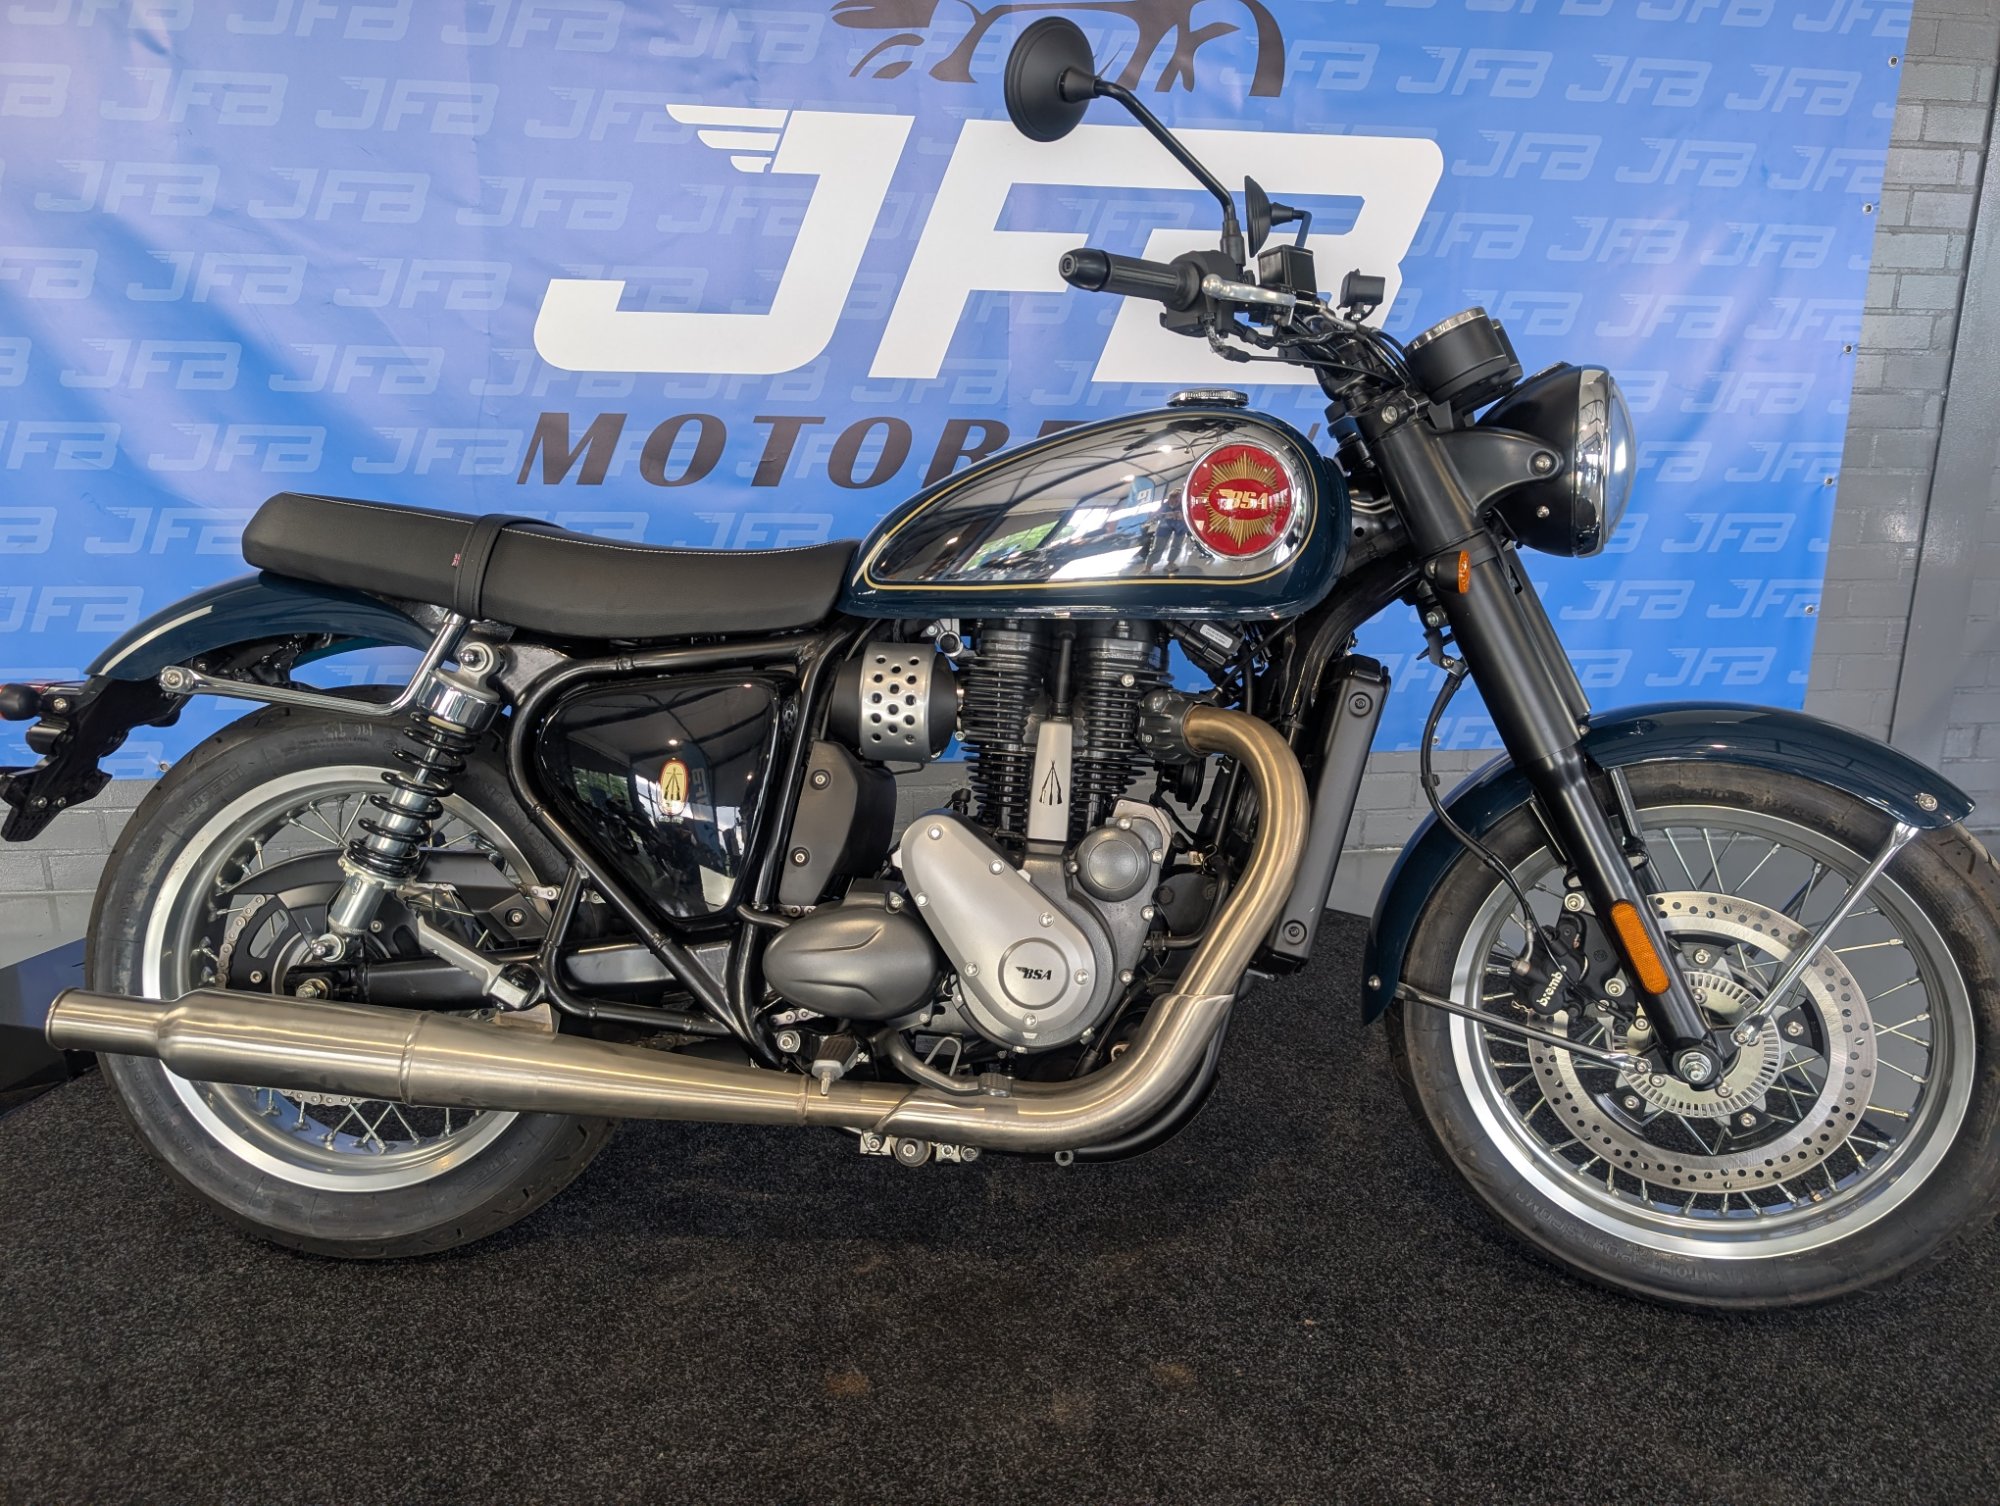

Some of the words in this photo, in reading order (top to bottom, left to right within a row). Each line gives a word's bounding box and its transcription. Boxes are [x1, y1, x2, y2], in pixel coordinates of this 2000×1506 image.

[440, 0, 618, 52] JFB
[647, 2, 826, 64] JFB
[99, 66, 288, 126] JFB
[1396, 46, 1553, 98] JFB
[1566, 54, 1712, 107] JFB
[1724, 64, 1862, 116] JFB
[315, 76, 499, 135] JFB
[523, 86, 697, 144] JFB
[1451, 129, 1602, 180] JFB
[1615, 137, 1755, 187] JFB
[34, 159, 220, 217] JFB
[247, 166, 431, 224] JFB
[455, 176, 633, 231] JFB
[534, 104, 1443, 384] JFB
[1546, 216, 1689, 264] JFB
[1700, 222, 1836, 270] JFB
[126, 250, 307, 305] JFB
[333, 258, 512, 310] JFB
[1595, 294, 1735, 339] JFB
[60, 338, 242, 390] JFB
[269, 344, 444, 395] JFB
[1682, 372, 1814, 414] JFB
[0, 421, 121, 471] FB
[148, 423, 326, 473] JFB
[351, 427, 524, 475] JFB
[517, 411, 1100, 489] MOTOR
[1219, 489, 1269, 510] BSA
[1662, 513, 1793, 553] JFB
[1562, 580, 1689, 620] JFB
[1646, 648, 1770, 686] JFB
[1015, 966, 1052, 981] BSA
